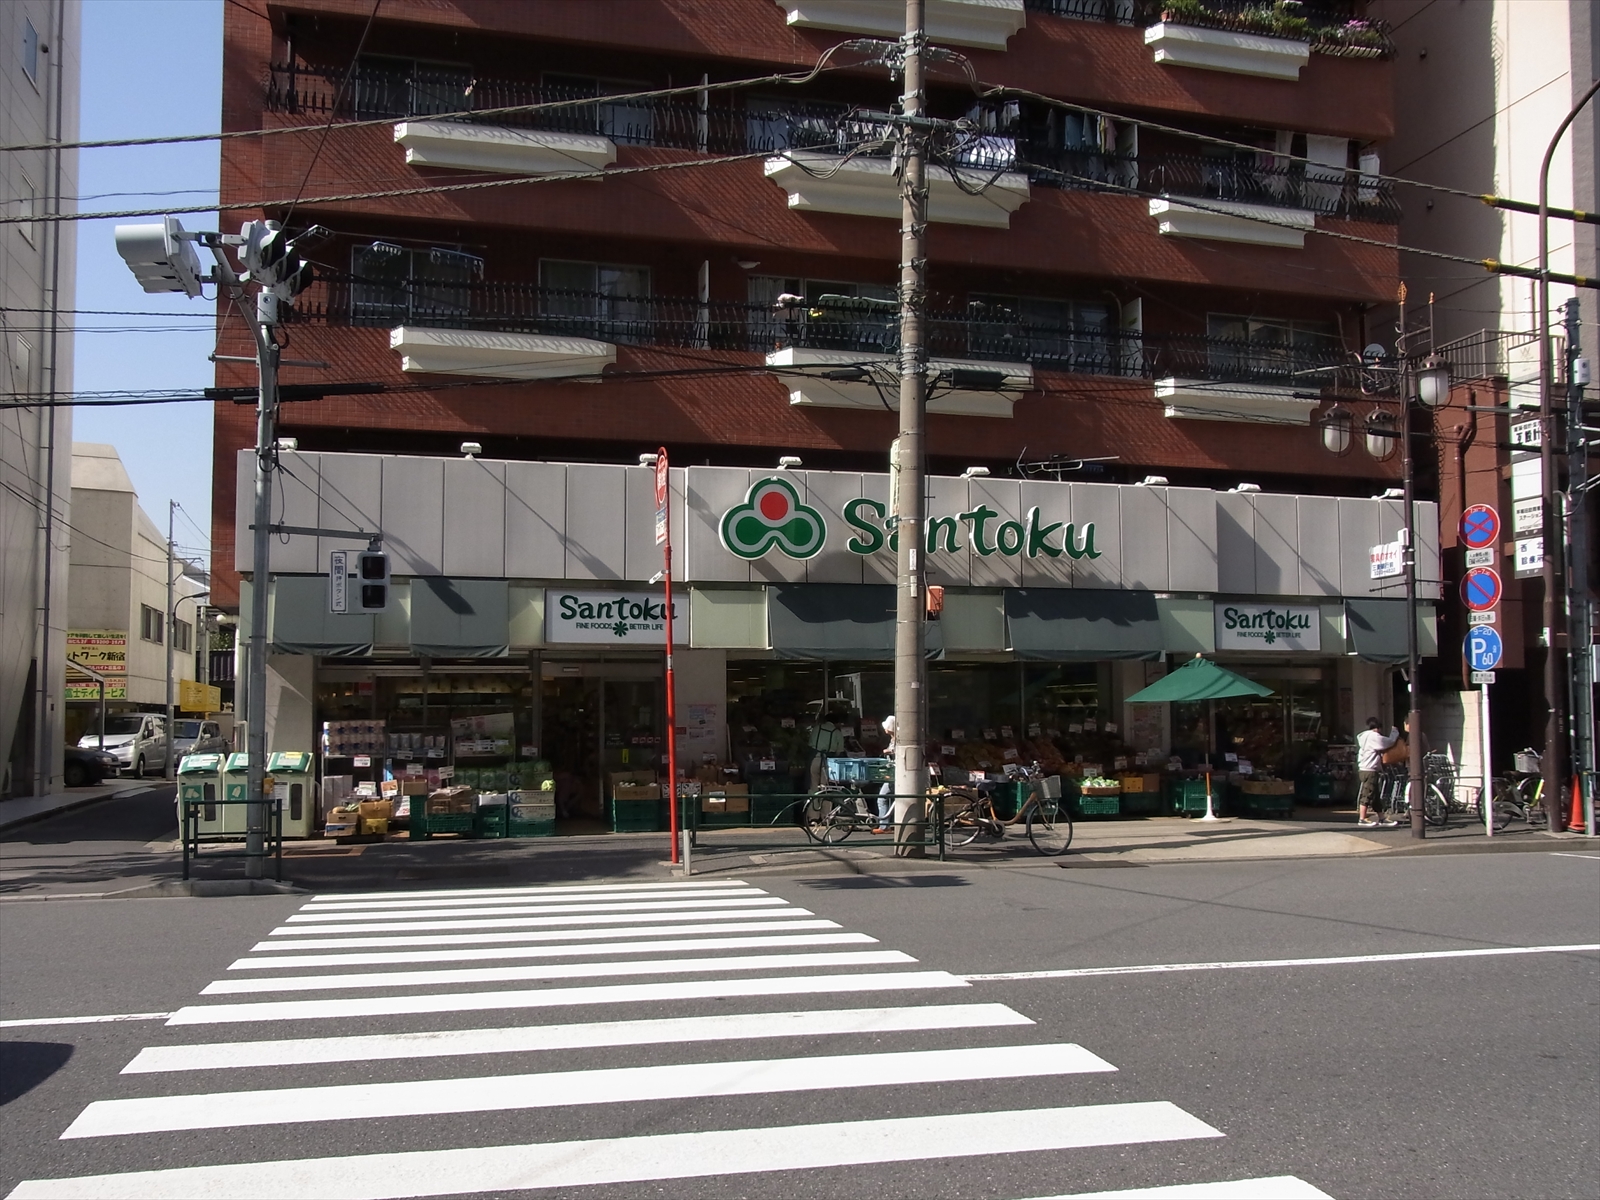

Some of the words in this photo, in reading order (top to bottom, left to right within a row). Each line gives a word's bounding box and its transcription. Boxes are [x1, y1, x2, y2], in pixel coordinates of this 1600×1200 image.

[559, 595, 678, 621] Santoku
[1224, 607, 1311, 630] Santoku
[590, 622, 612, 630] FOODS
[651, 623, 663, 631] LIFE
[1482, 652, 1494, 665] 60
